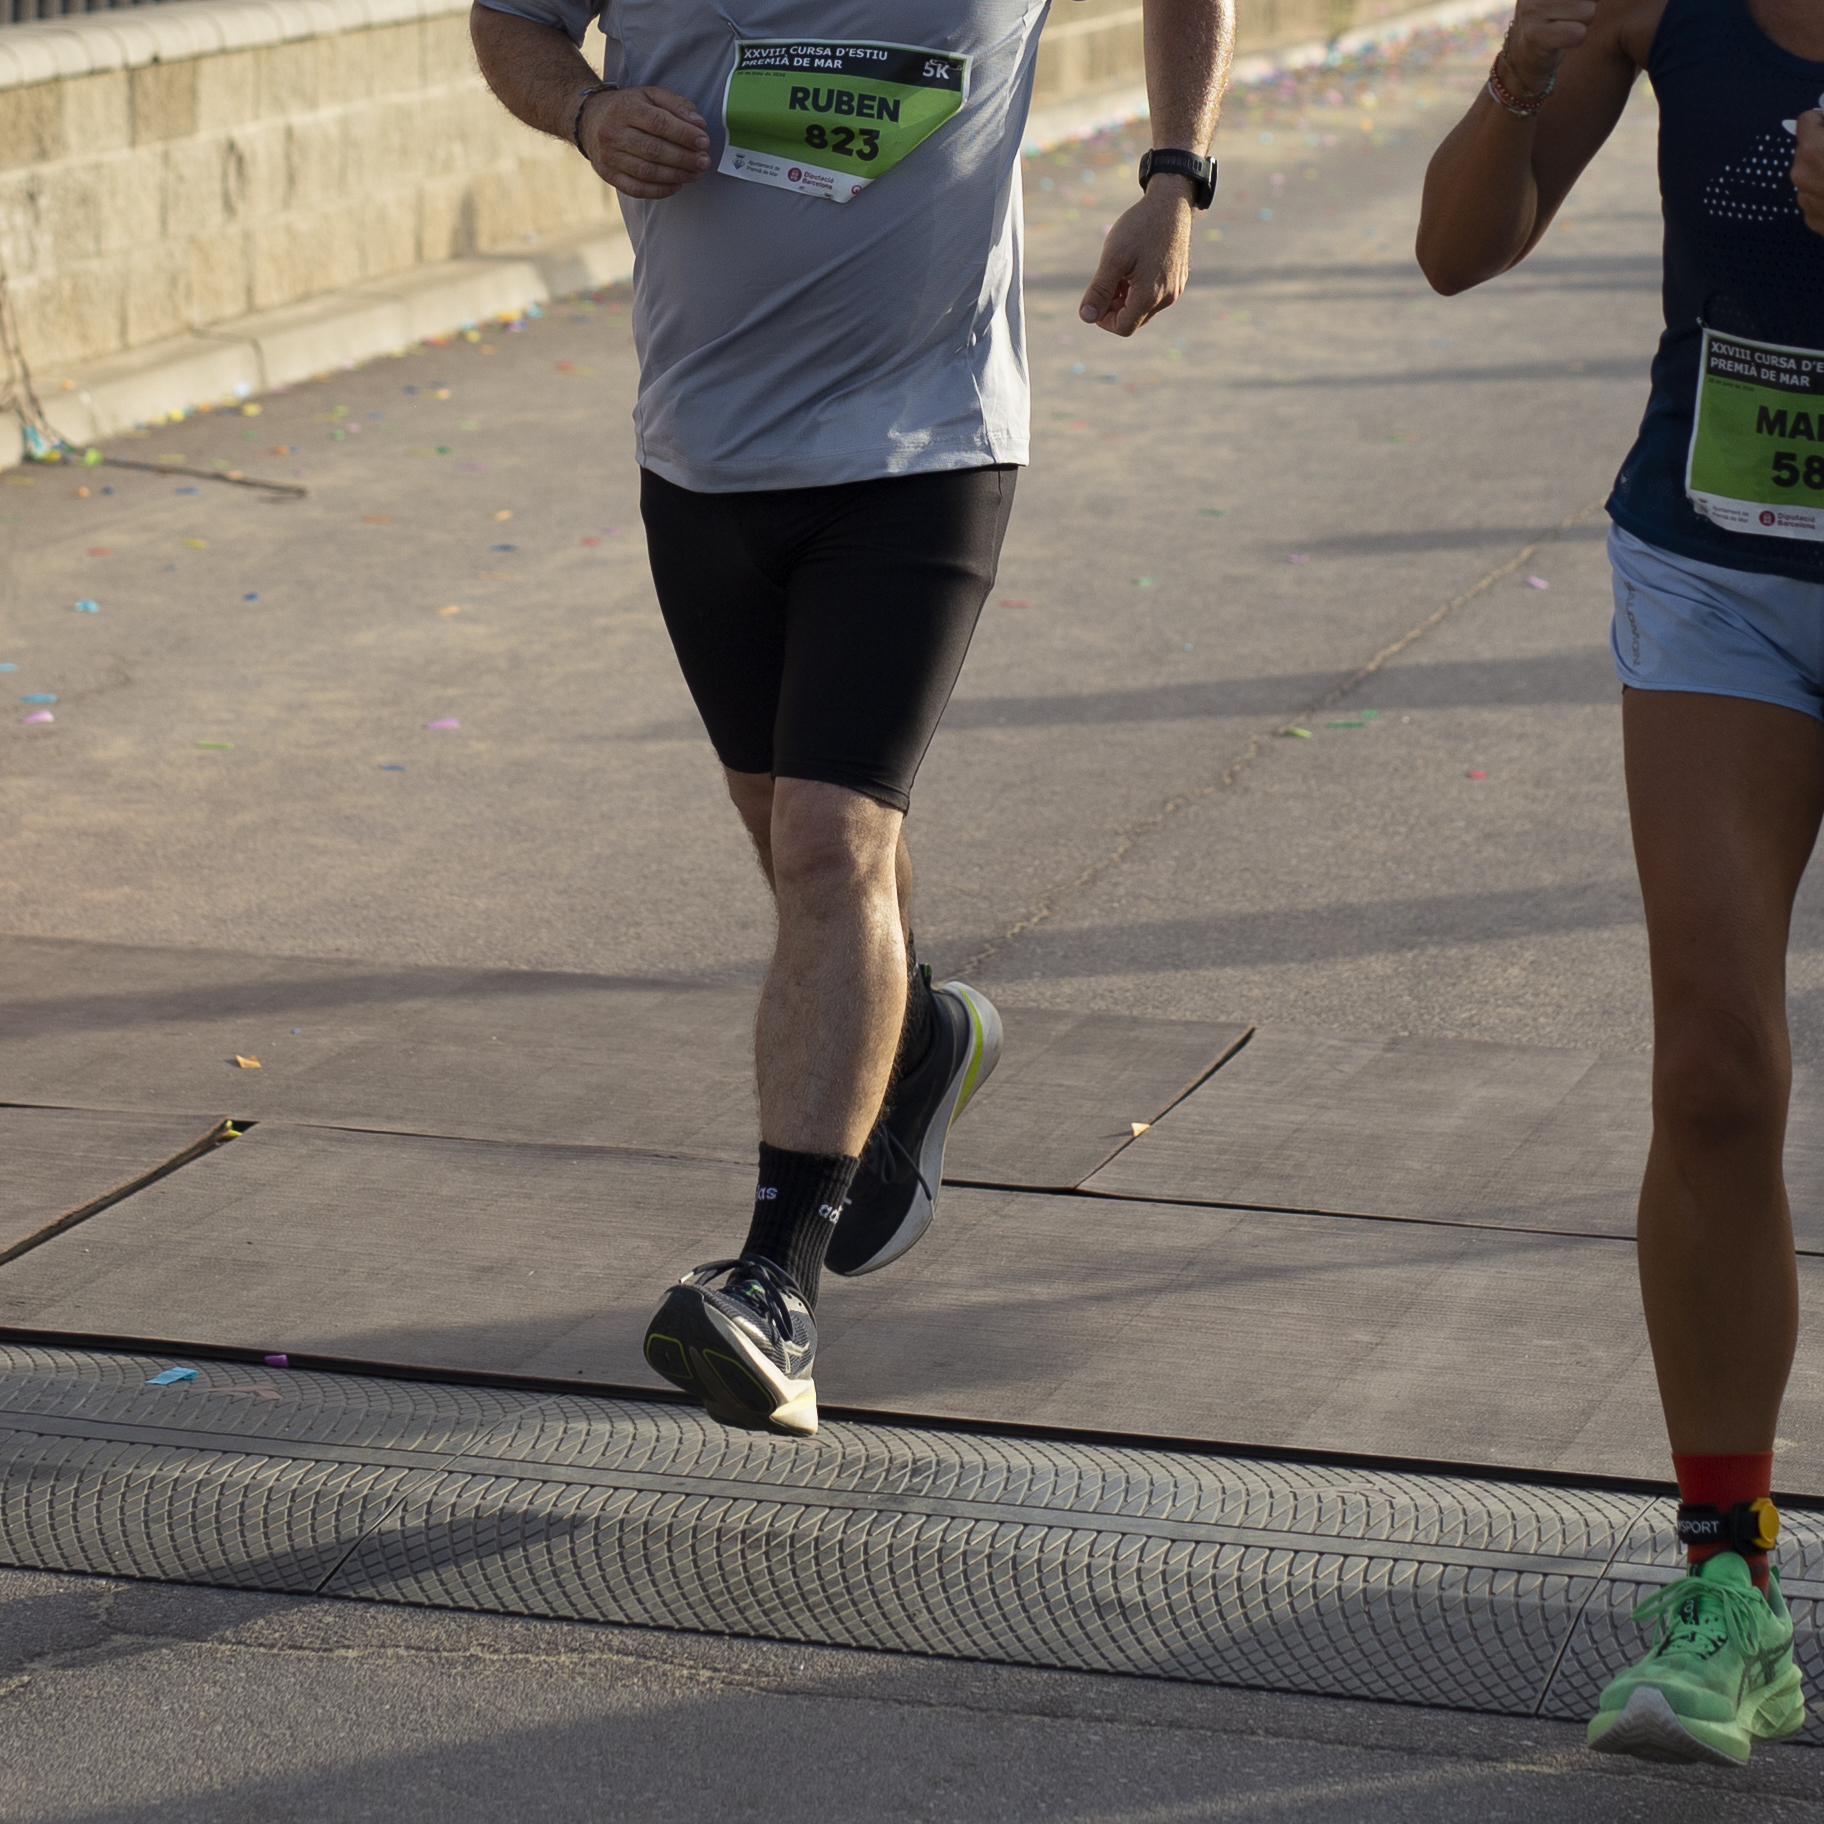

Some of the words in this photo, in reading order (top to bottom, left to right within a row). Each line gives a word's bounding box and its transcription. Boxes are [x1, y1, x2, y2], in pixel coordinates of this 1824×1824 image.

[741, 54, 789, 68] PREMIÀ
[793, 57, 811, 67] DE
[814, 59, 843, 69] MAR
[743, 47, 787, 59] XXVIII
[789, 46, 832, 57] CURSA
[835, 47, 888, 61] D'ESTIU
[922, 62, 949, 80] 5K
[788, 86, 901, 123] RUBEN
[805, 124, 880, 161] 823
[1711, 341, 1751, 361] XXVIII
[1754, 352, 1797, 370] CURSA
[1710, 357, 1757, 377] PREMIÀ
[1760, 368, 1777, 382] DE
[1779, 373, 1810, 387] MAR
